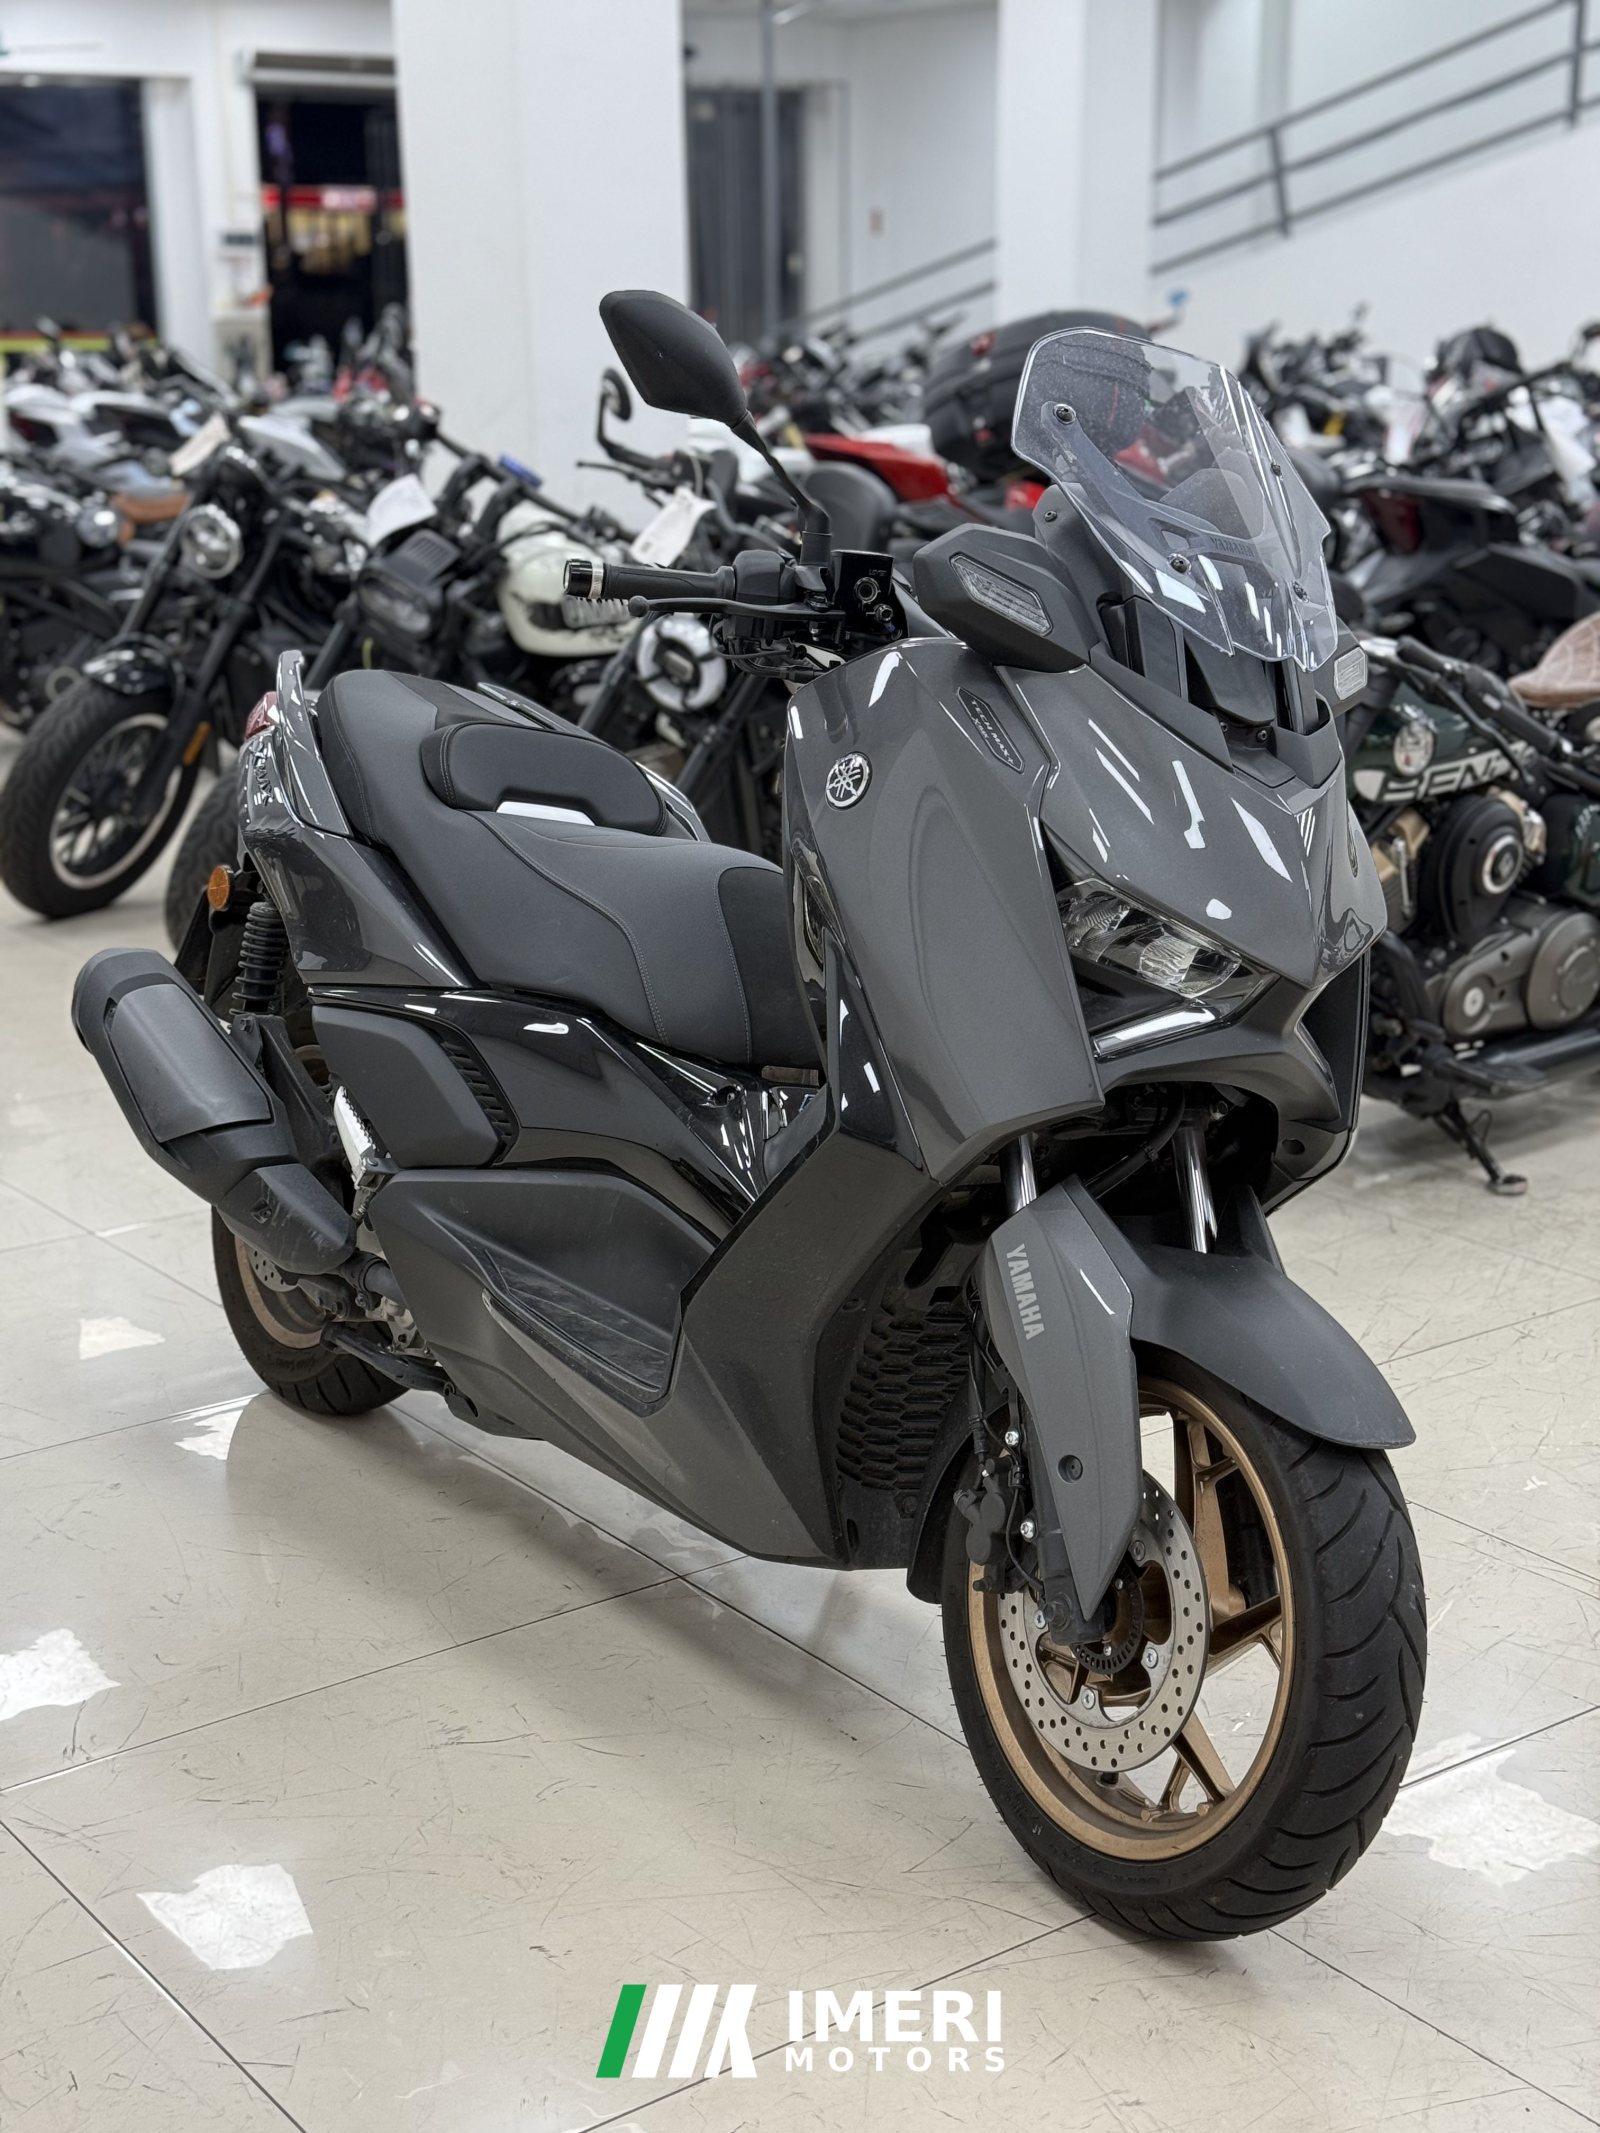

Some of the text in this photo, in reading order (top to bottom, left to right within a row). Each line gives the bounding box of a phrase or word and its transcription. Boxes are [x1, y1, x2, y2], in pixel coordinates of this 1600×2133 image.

[1208, 535, 1256, 559] YAMAHA
[970, 700, 994, 731] TECH
[1006, 1243, 1045, 1340] YAMAHA
